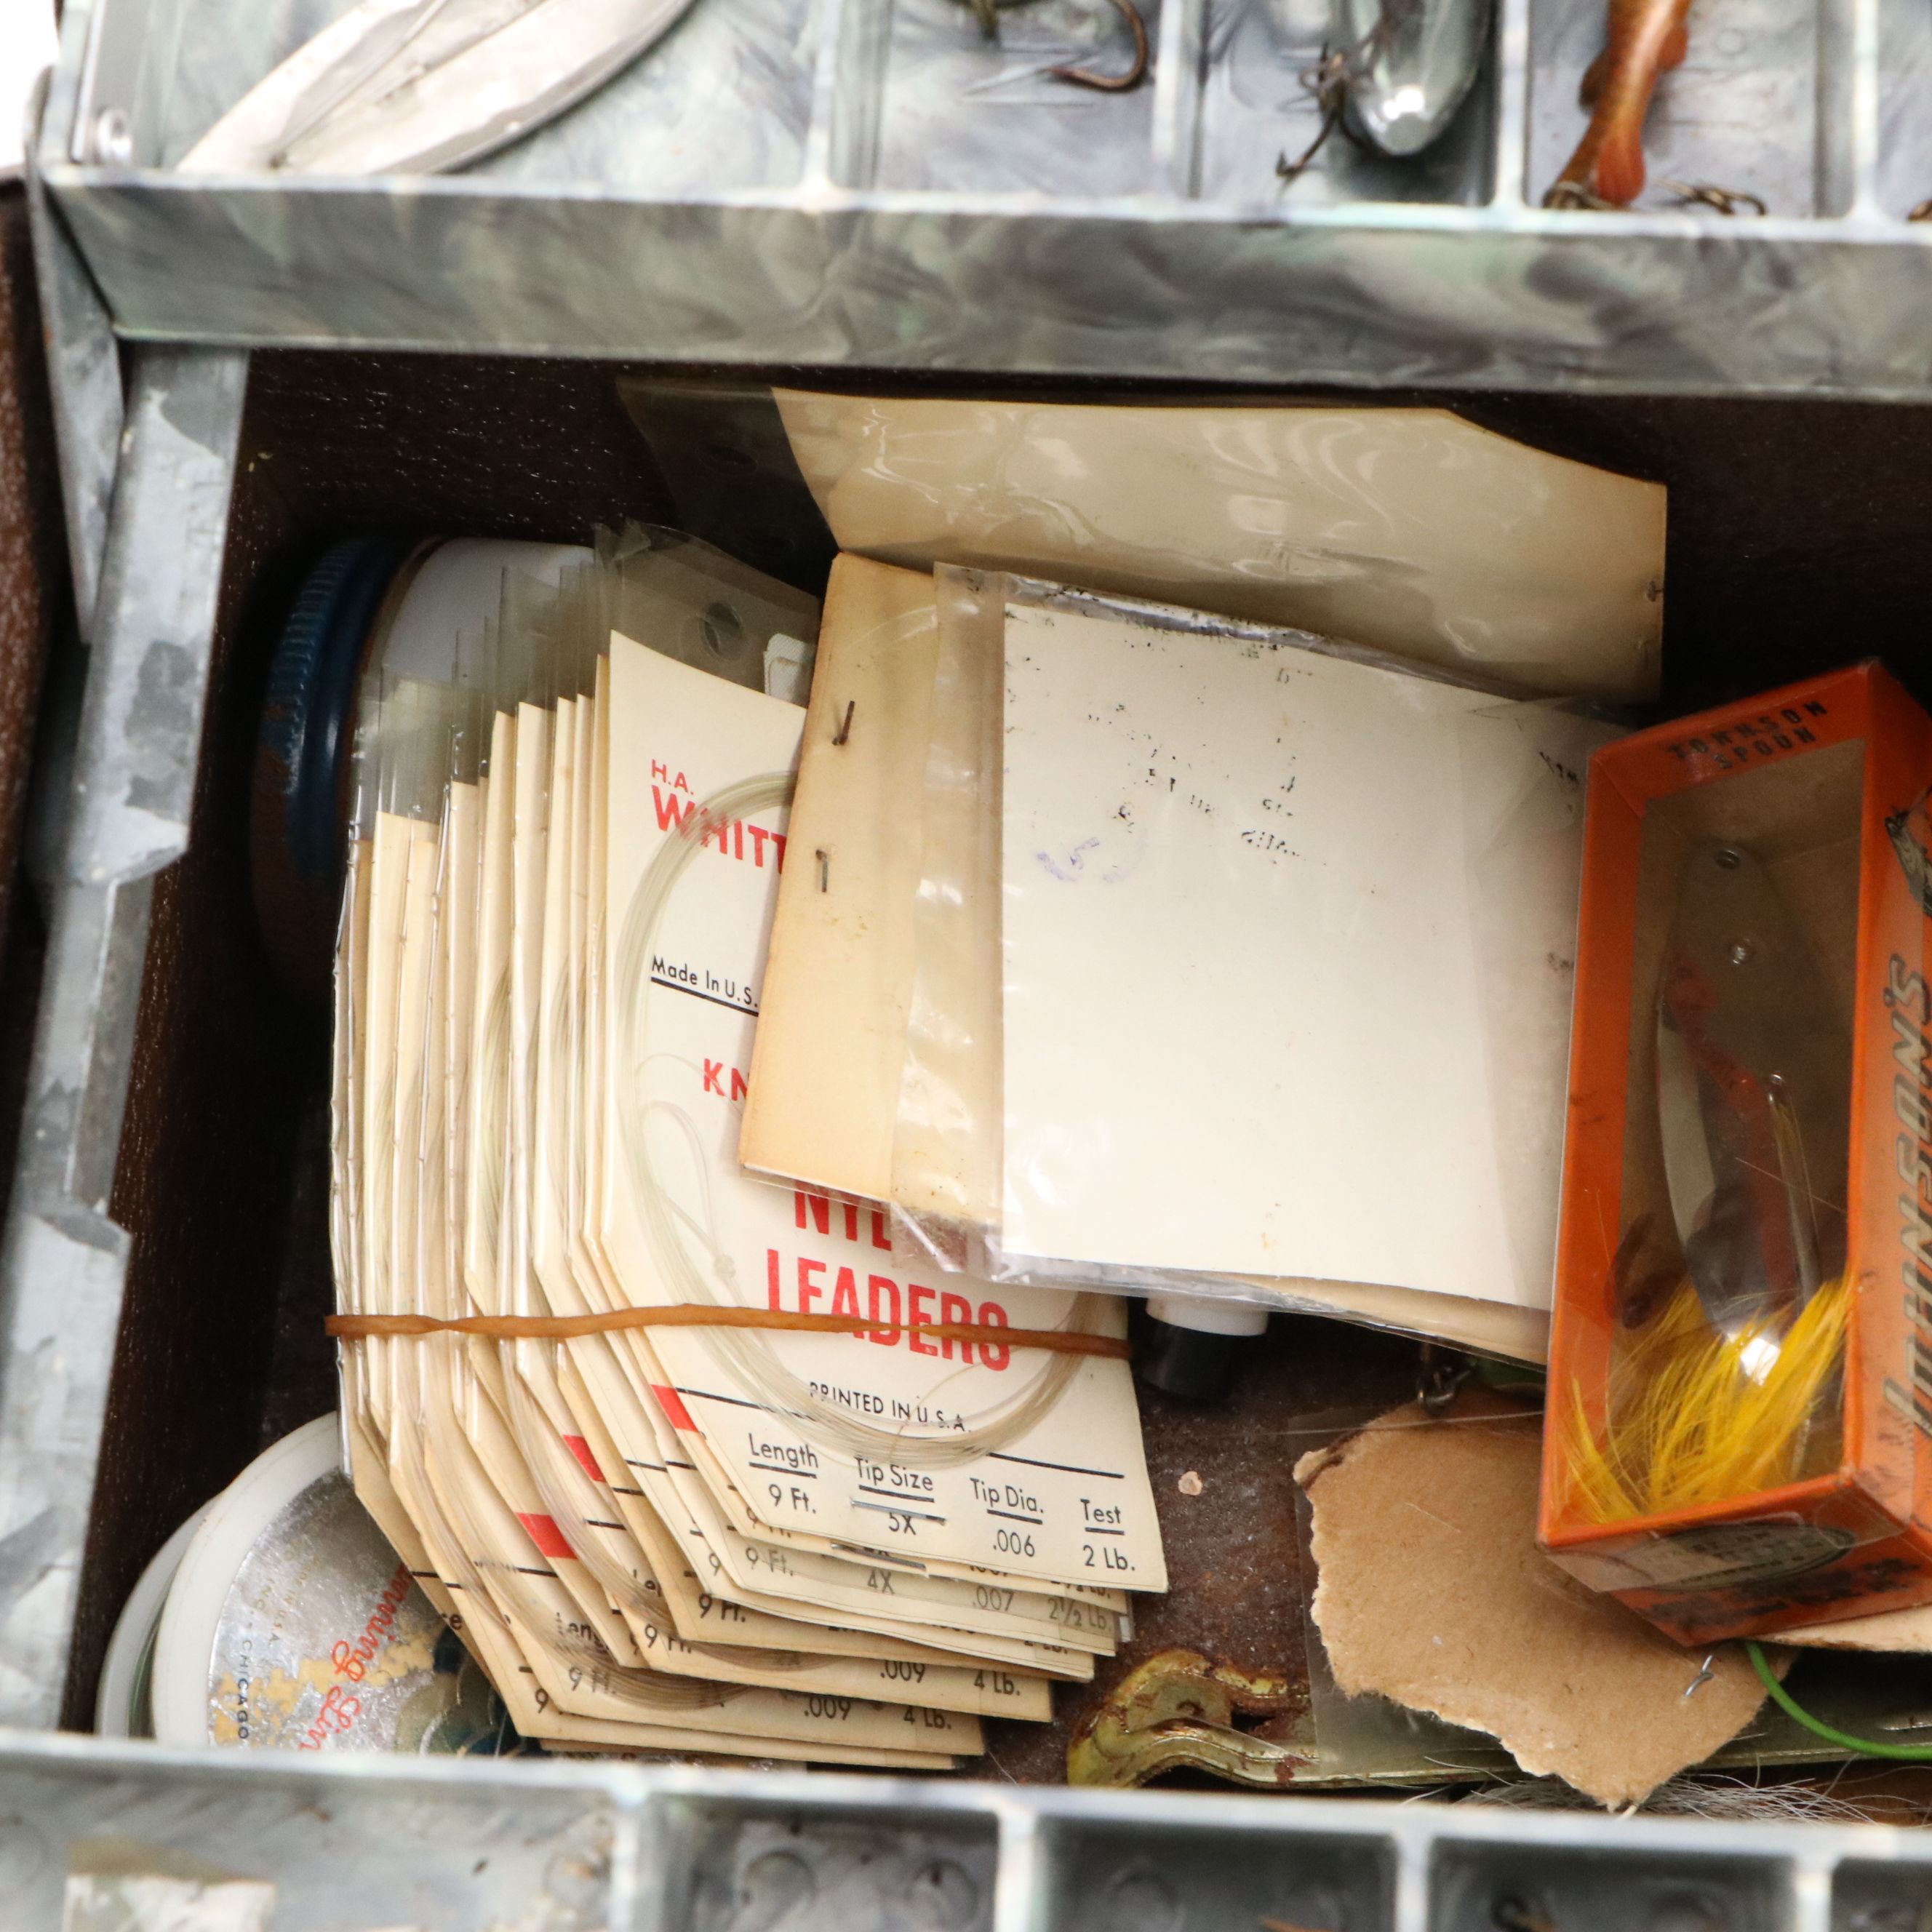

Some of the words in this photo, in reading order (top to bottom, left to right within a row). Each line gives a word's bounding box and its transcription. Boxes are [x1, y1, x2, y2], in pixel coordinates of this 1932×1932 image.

[652, 759, 694, 796] H.A.
[652, 954, 698, 986] Made
[706, 970, 720, 992] In
[767, 1249, 1011, 1371] LEADERS
[810, 1381, 884, 1414] PRINTED
[893, 1399, 911, 1421] IN
[748, 1432, 819, 1469] Length
[854, 1456, 885, 1486] Tip
[890, 1464, 934, 1492] Size
[970, 1477, 1000, 1508] Tip
[1005, 1485, 1045, 1514] Dia.
[1080, 1498, 1122, 1525] Test
[768, 1483, 782, 1507] 9
[791, 1487, 817, 1514] Ft.
[888, 1512, 917, 1535] 5X
[992, 1528, 1036, 1558] .006
[1083, 1544, 1095, 1568] 2
[1103, 1546, 1135, 1572] Lb.
[746, 1546, 759, 1570] 9
[866, 1568, 895, 1595] 4X
[698, 1592, 713, 1618] 9
[644, 1623, 658, 1648] 9
[973, 1669, 986, 1691] 4
[992, 1670, 1021, 1696] Lb.
[236, 1639, 254, 1740] CHICAGO
[535, 1688, 549, 1715] 9
[903, 1704, 916, 1725] 4
